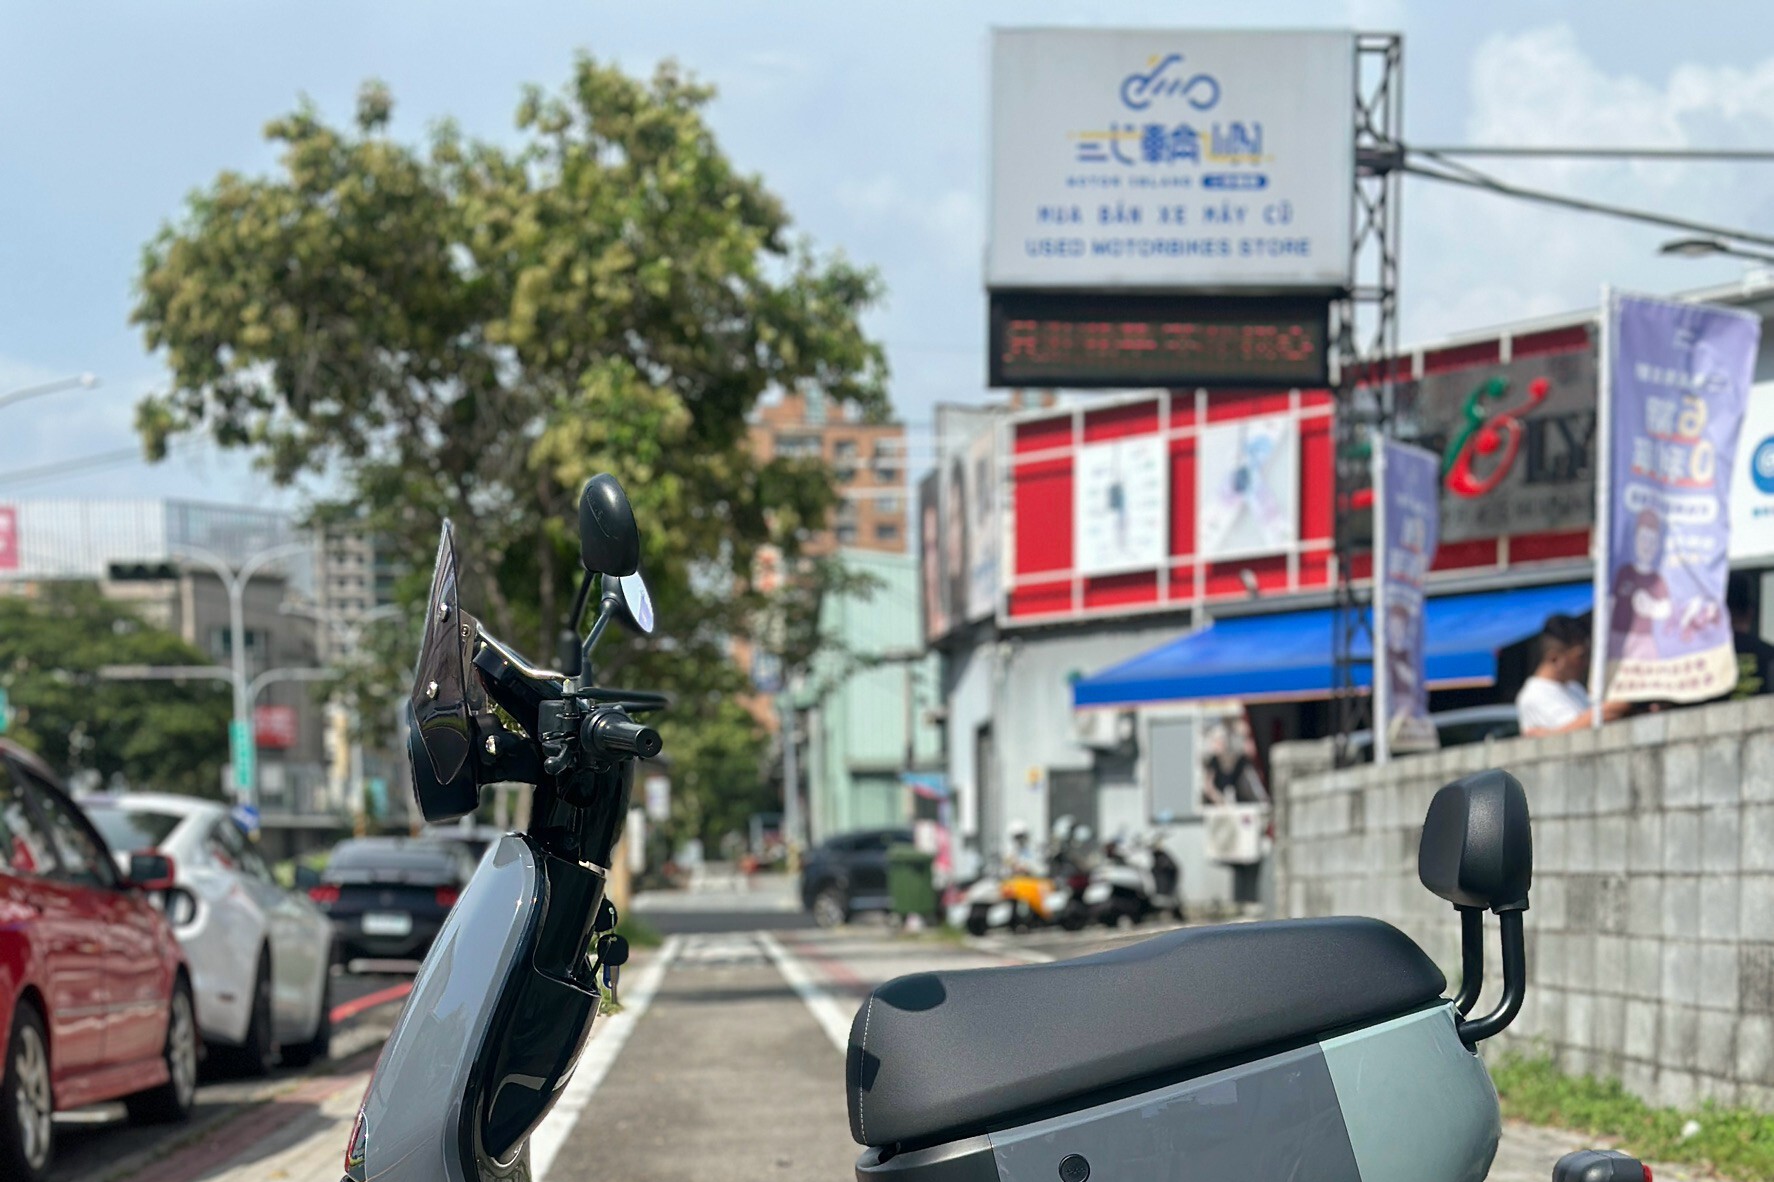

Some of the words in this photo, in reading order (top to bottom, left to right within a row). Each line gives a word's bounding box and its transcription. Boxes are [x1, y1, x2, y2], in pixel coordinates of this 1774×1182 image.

[1025, 237, 1086, 257] USED
[1091, 237, 1231, 257] MOTORBIKES
[1238, 237, 1312, 257] STORE
